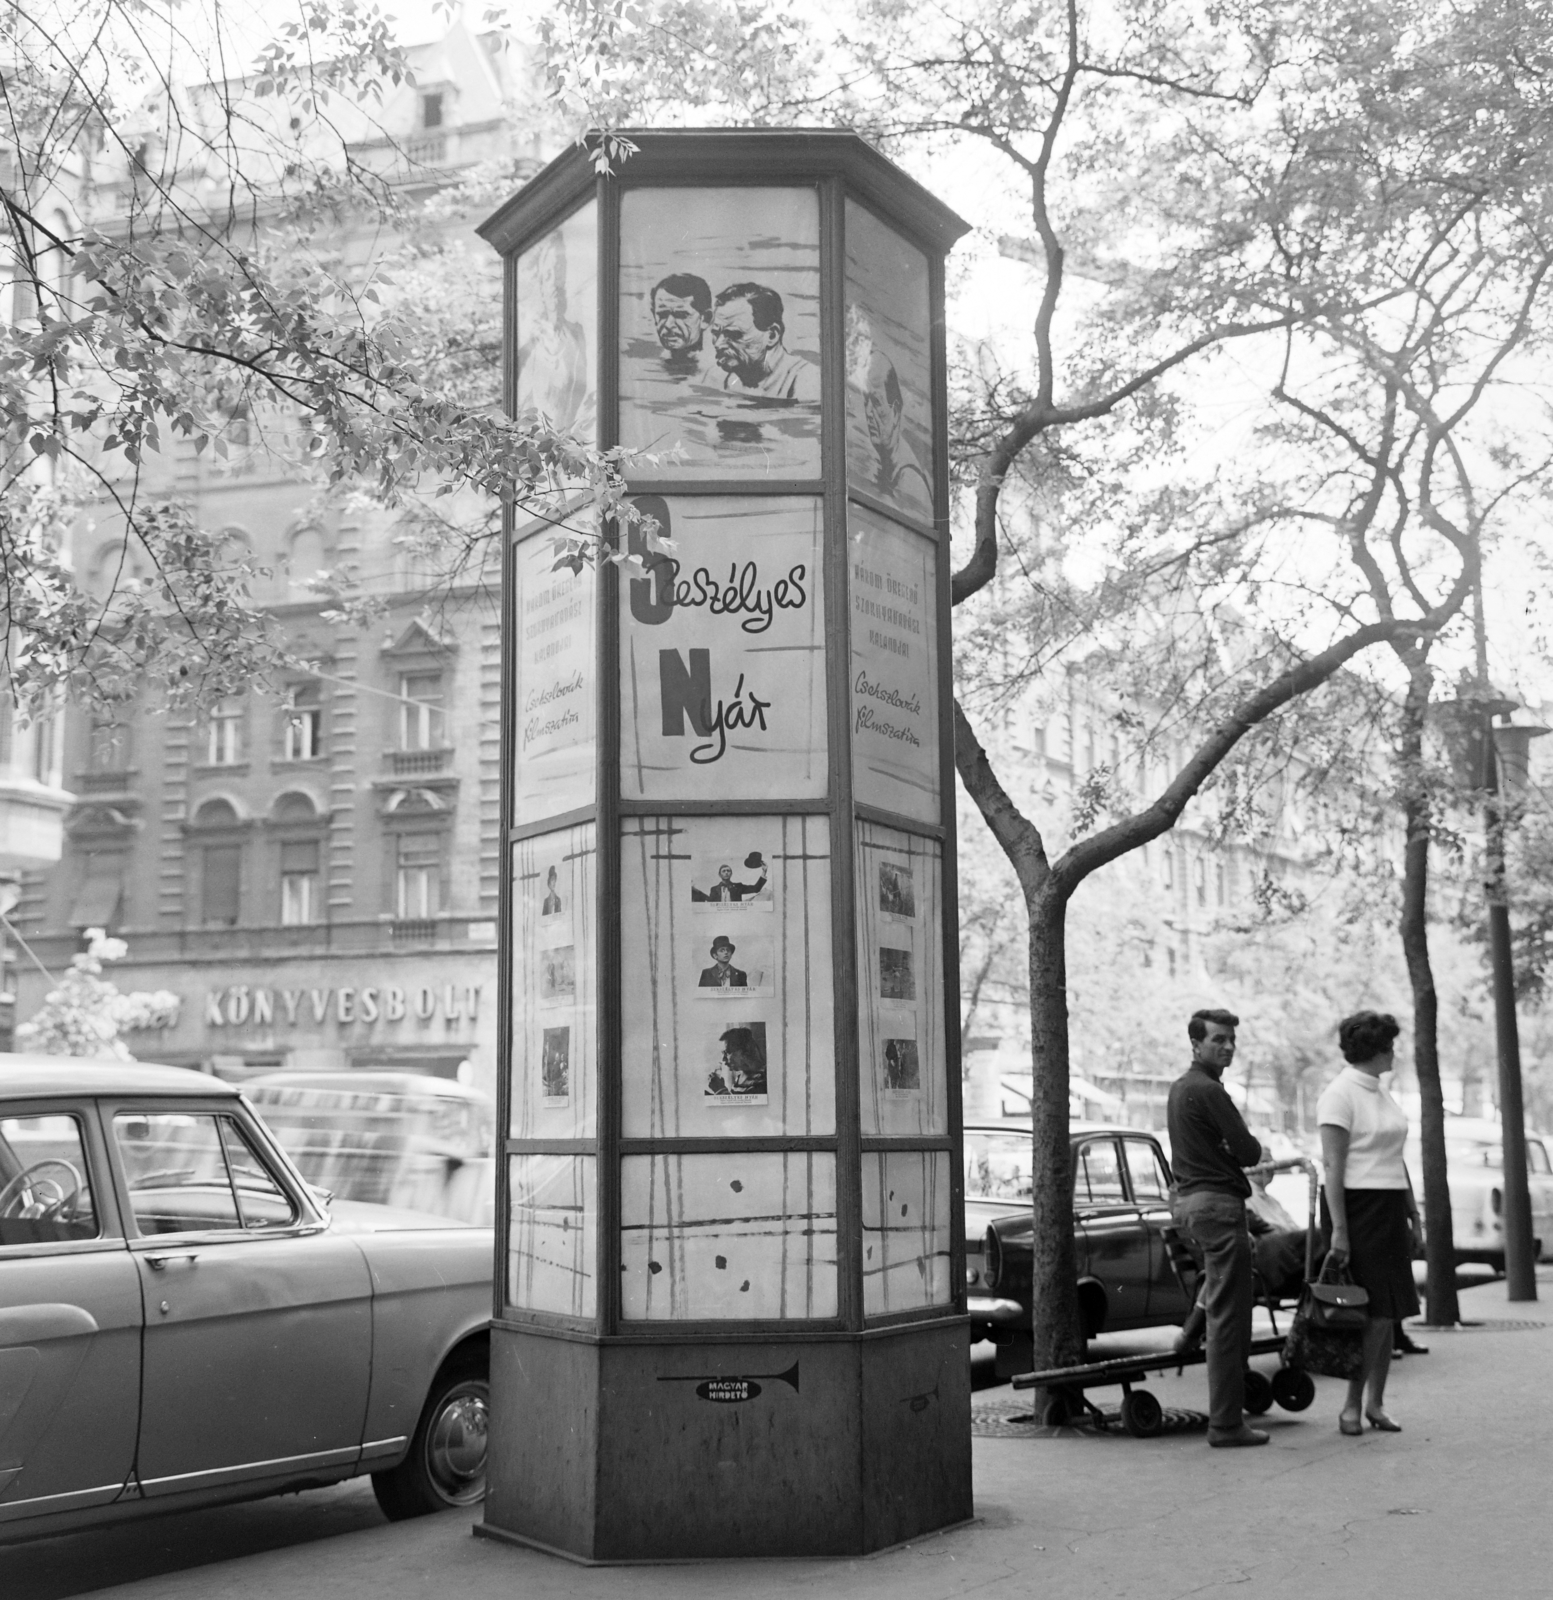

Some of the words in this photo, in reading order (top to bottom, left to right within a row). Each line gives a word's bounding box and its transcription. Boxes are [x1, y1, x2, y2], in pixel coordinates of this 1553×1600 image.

[659, 648, 771, 764] Nyár
[205, 984, 481, 1026] KÖNYVESBOLT
[708, 1382, 748, 1390] MAGYAR
